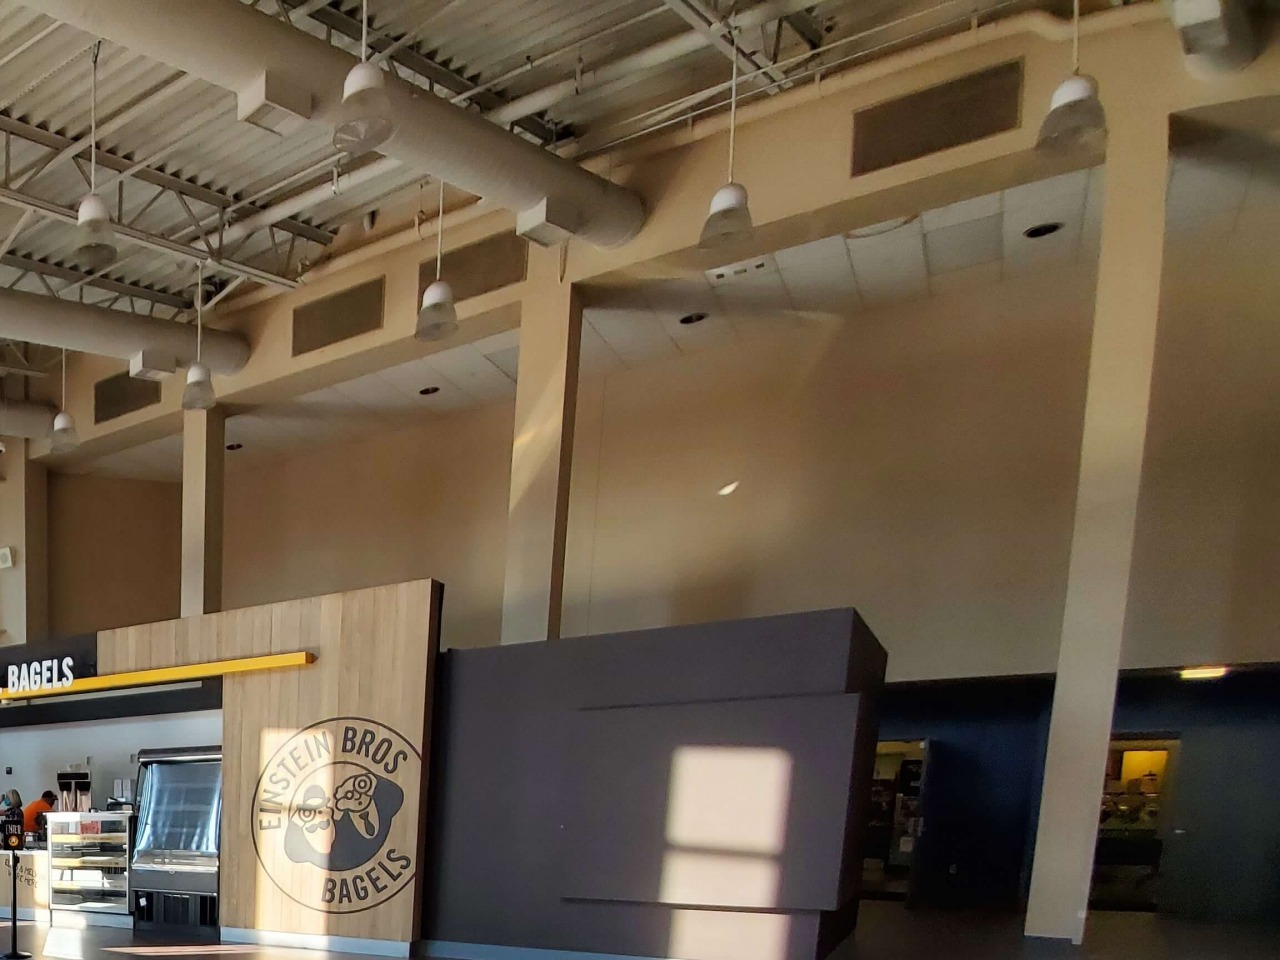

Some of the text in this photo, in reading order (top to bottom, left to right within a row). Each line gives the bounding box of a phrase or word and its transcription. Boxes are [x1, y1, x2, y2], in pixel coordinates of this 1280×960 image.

[7, 656, 74, 694] BAGELS
[259, 726, 408, 831] EINSTEIN BROS
[321, 848, 412, 904] BAGELS
